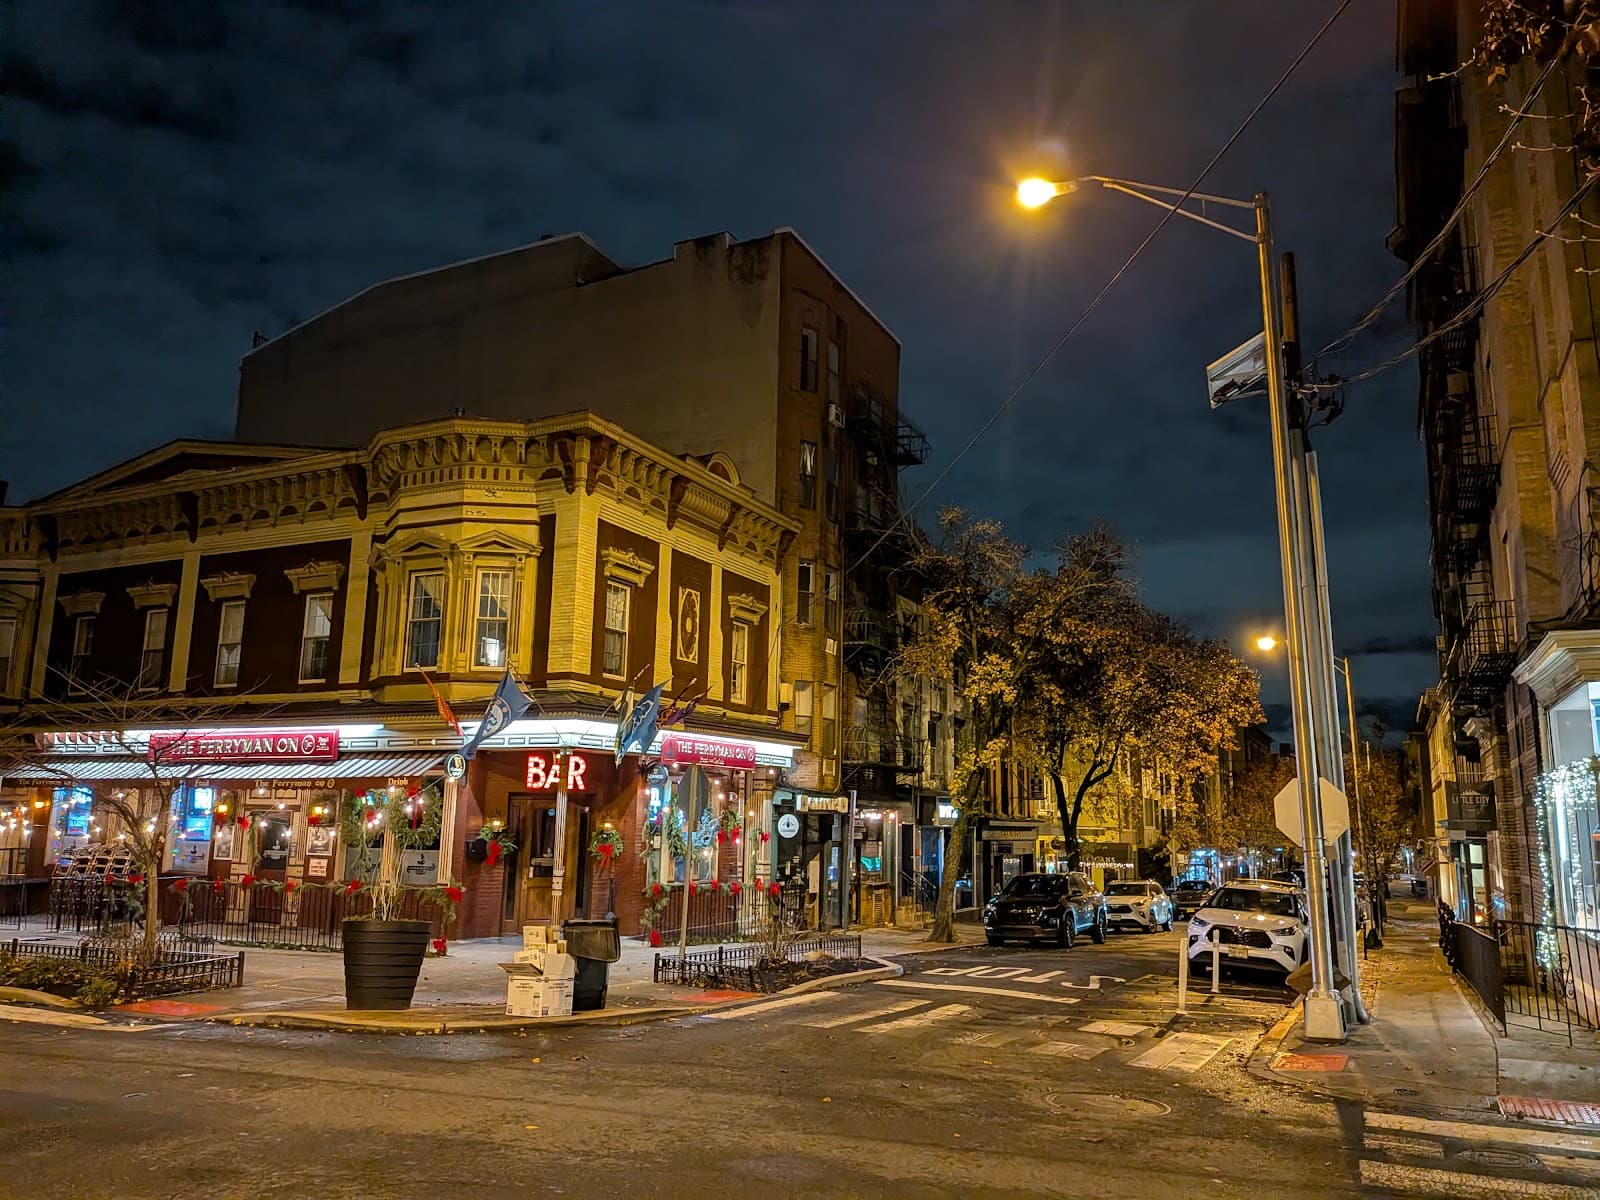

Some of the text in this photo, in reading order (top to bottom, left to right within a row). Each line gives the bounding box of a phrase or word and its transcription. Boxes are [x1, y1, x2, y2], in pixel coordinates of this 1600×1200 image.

[170, 740, 195, 755] THE
[198, 738, 273, 755] FERRYMAN
[276, 737, 298, 753] ON
[676, 740, 693, 754] THE
[694, 743, 735, 759] FERRYMAN
[735, 749, 746, 760] ON
[388, 777, 409, 786] Drink
[526, 755, 586, 790] BAR
[254, 780, 269, 788] The
[272, 780, 312, 789] Ferryman
[1451, 796, 1490, 804] LITTLE CITY
[921, 965, 1126, 990] STOP
